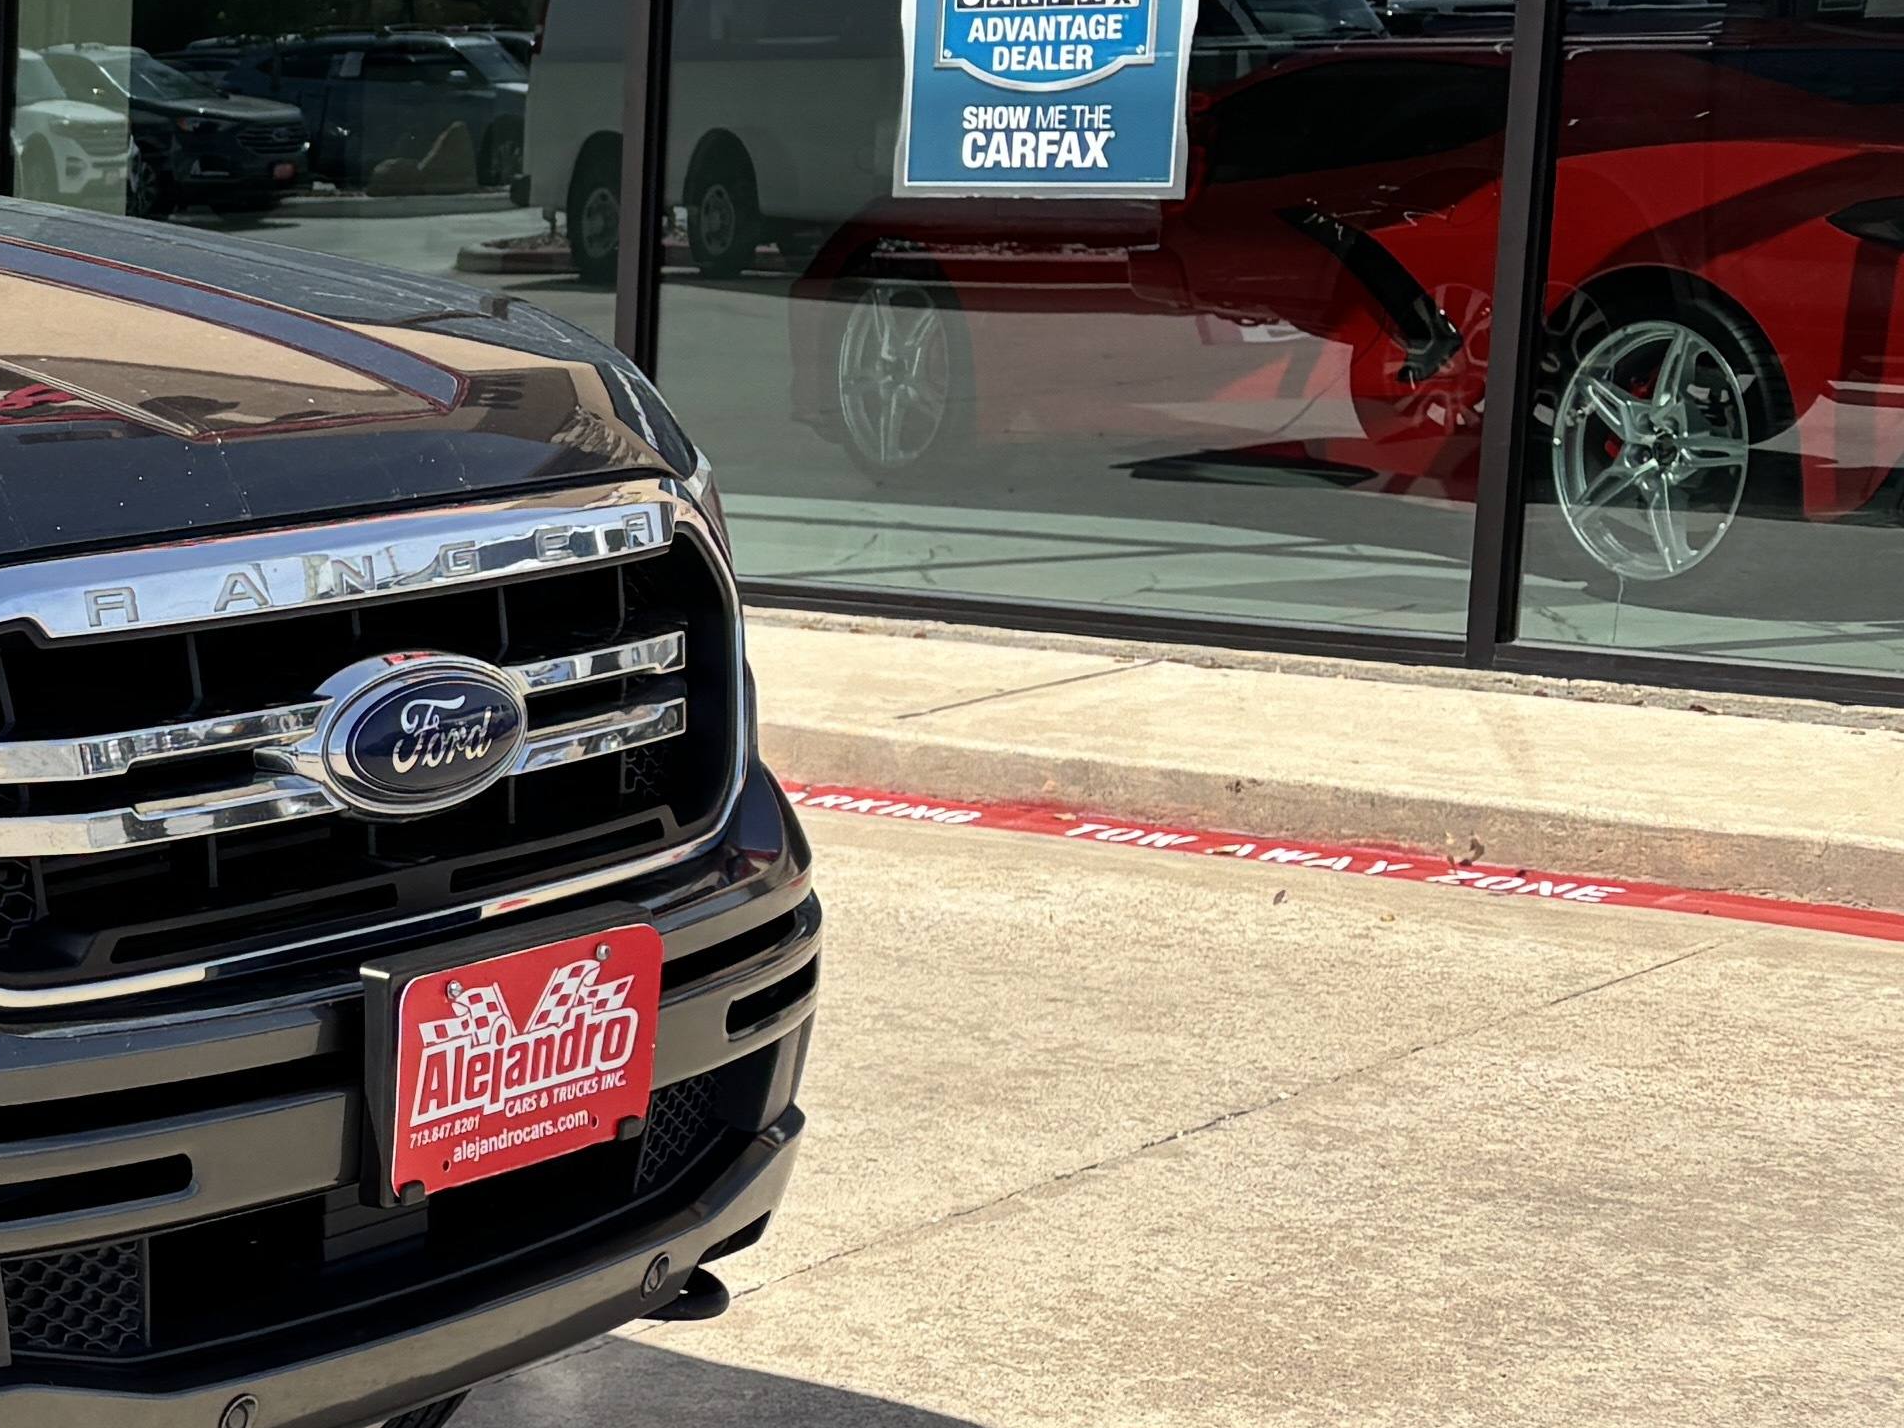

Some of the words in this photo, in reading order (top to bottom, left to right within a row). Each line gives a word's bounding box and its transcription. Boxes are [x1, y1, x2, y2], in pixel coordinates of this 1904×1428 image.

[967, 14, 1124, 43] ADVANTAGE
[992, 44, 1094, 71] DEALER
[962, 105, 1030, 130] SHOW
[1035, 105, 1068, 129] ME
[1071, 105, 1112, 130] THE
[961, 130, 1115, 169] CARFAX
[86, 511, 664, 628] RANGER
[391, 693, 492, 772] Ford
[785, 791, 982, 824] RKING
[1064, 822, 1200, 848] TOW
[1203, 843, 1415, 875] AWAY
[1426, 869, 1626, 904] ZONE
[412, 1009, 637, 1122] Alejandro
[504, 1094, 537, 1118] CARS
[538, 1095, 549, 1109] &
[552, 1078, 599, 1104] TRUCKS
[600, 1069, 627, 1090] INC.
[409, 1114, 480, 1149] 713.847.8201
[452, 1109, 589, 1163] alejandrocars.com
